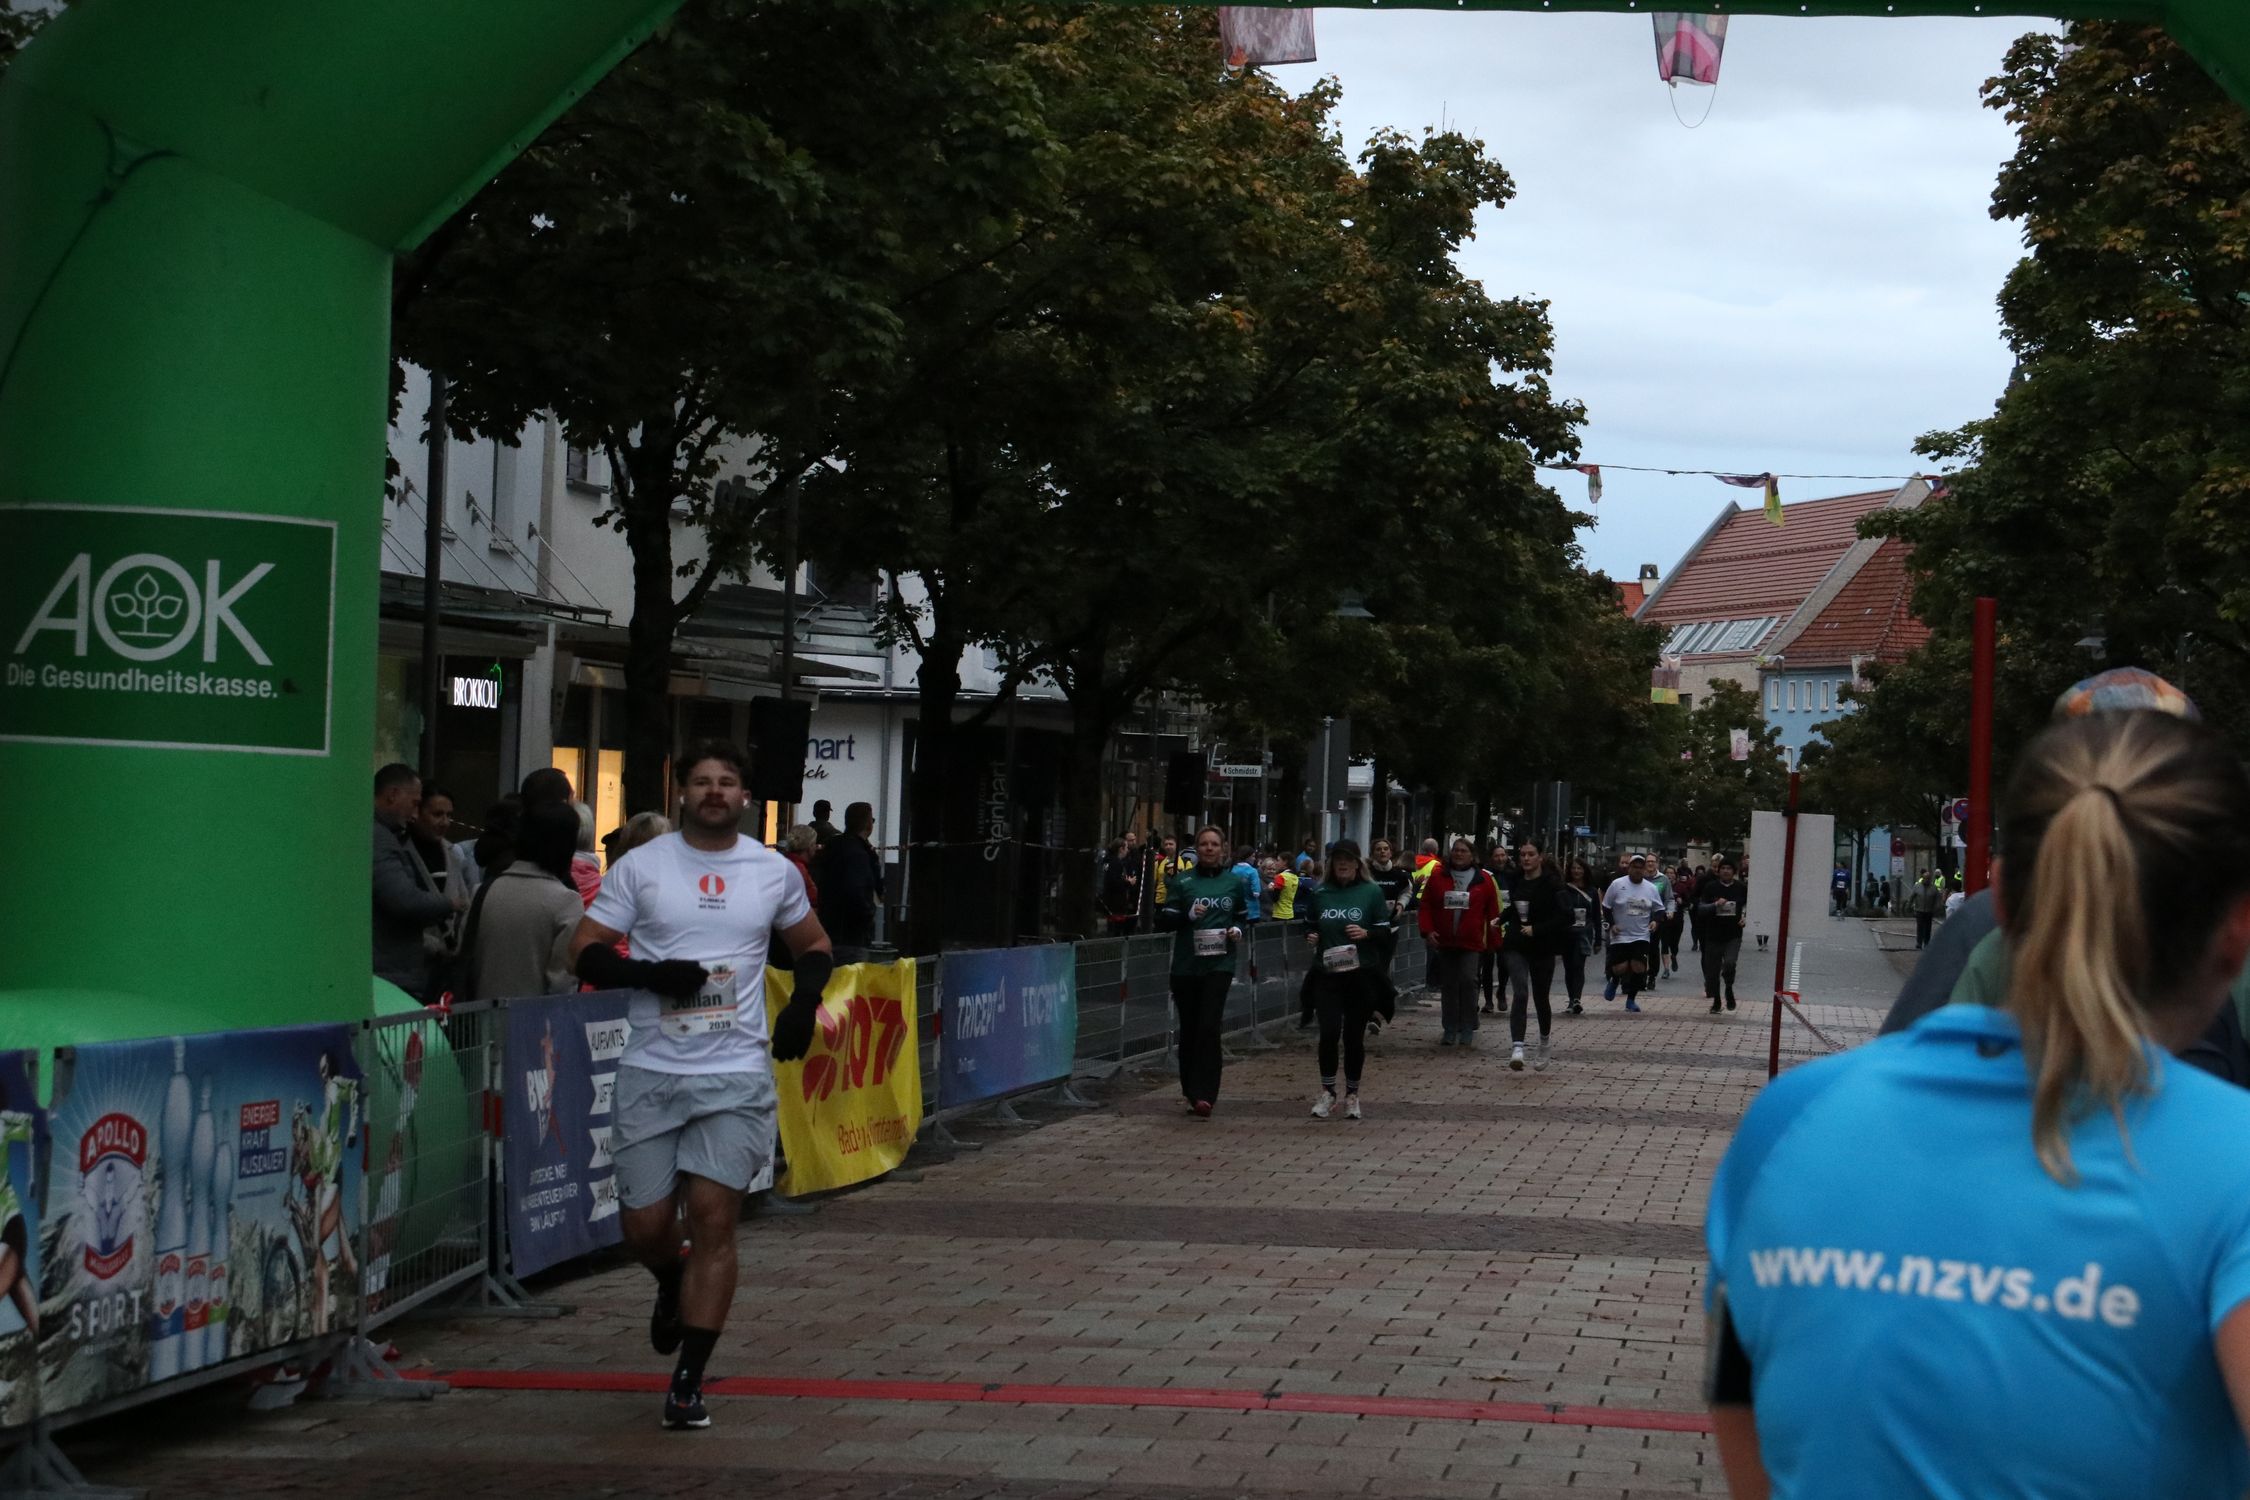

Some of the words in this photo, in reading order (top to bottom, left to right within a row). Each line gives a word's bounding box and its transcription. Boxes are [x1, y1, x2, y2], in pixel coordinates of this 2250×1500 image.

[13, 552, 276, 666] AOK
[6, 663, 36, 687] Die
[41, 664, 279, 700] Gesundheitskasse.
[453, 676, 498, 709] BROKKOLI
[1227, 767, 1258, 776] Schmidstr.
[983, 757, 1007, 862] Steinhart
[1320, 908, 1347, 920] AOK
[708, 1020, 732, 1030] 2039
[86, 1120, 140, 1159] APOLLO
[1749, 1246, 2142, 1330] www.nzvs.de
[71, 1289, 143, 1339] SPORT
